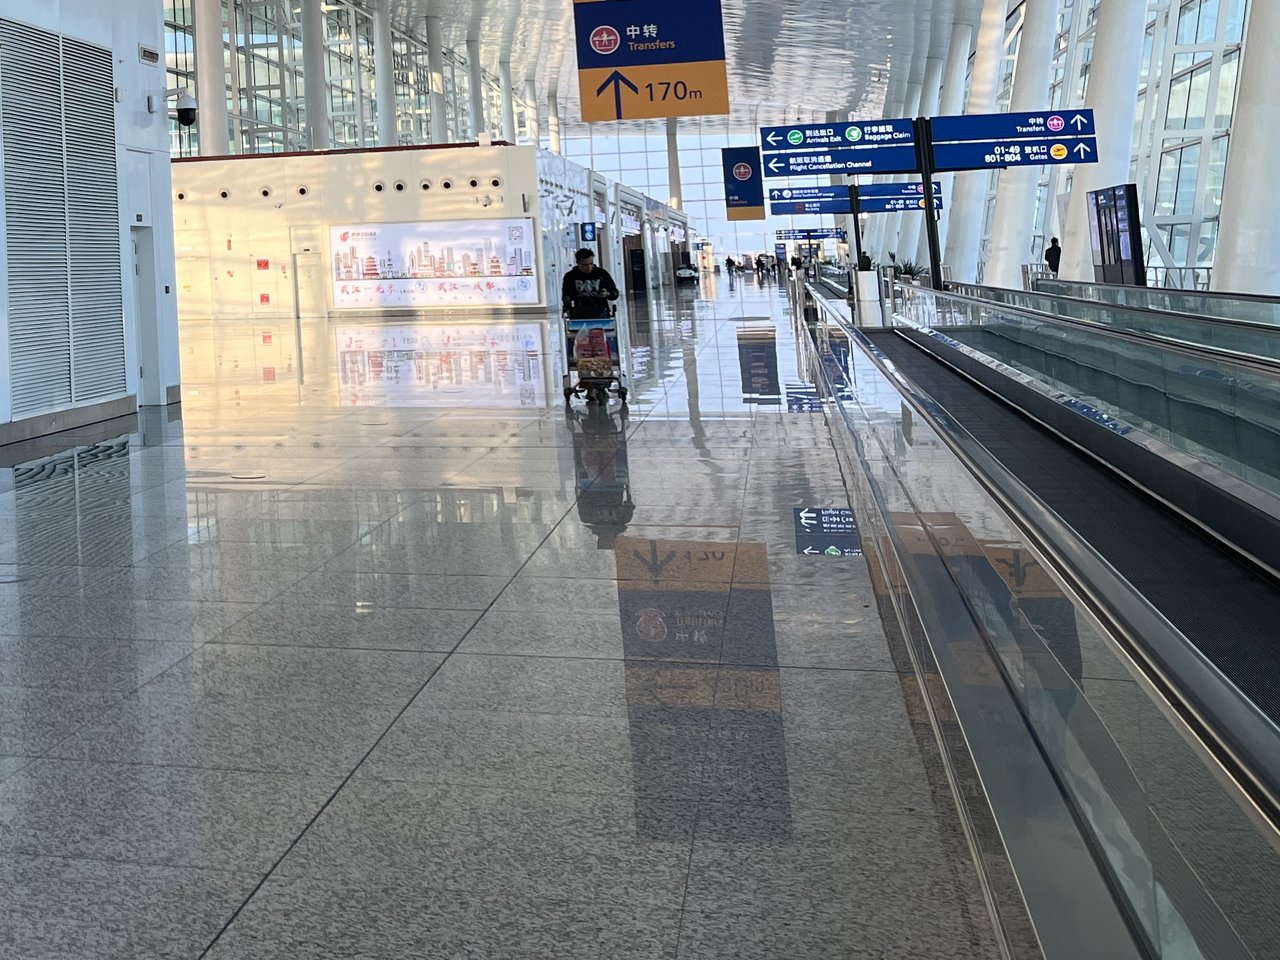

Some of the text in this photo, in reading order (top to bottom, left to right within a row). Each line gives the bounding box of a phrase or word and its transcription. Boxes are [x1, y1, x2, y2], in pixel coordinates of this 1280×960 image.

[626, 24, 658, 39] 中转
[628, 39, 676, 51] Transfers
[645, 80, 703, 102] 170m
[864, 133, 892, 141] Baggage
[790, 160, 872, 172] Flight Cancellation Channel
